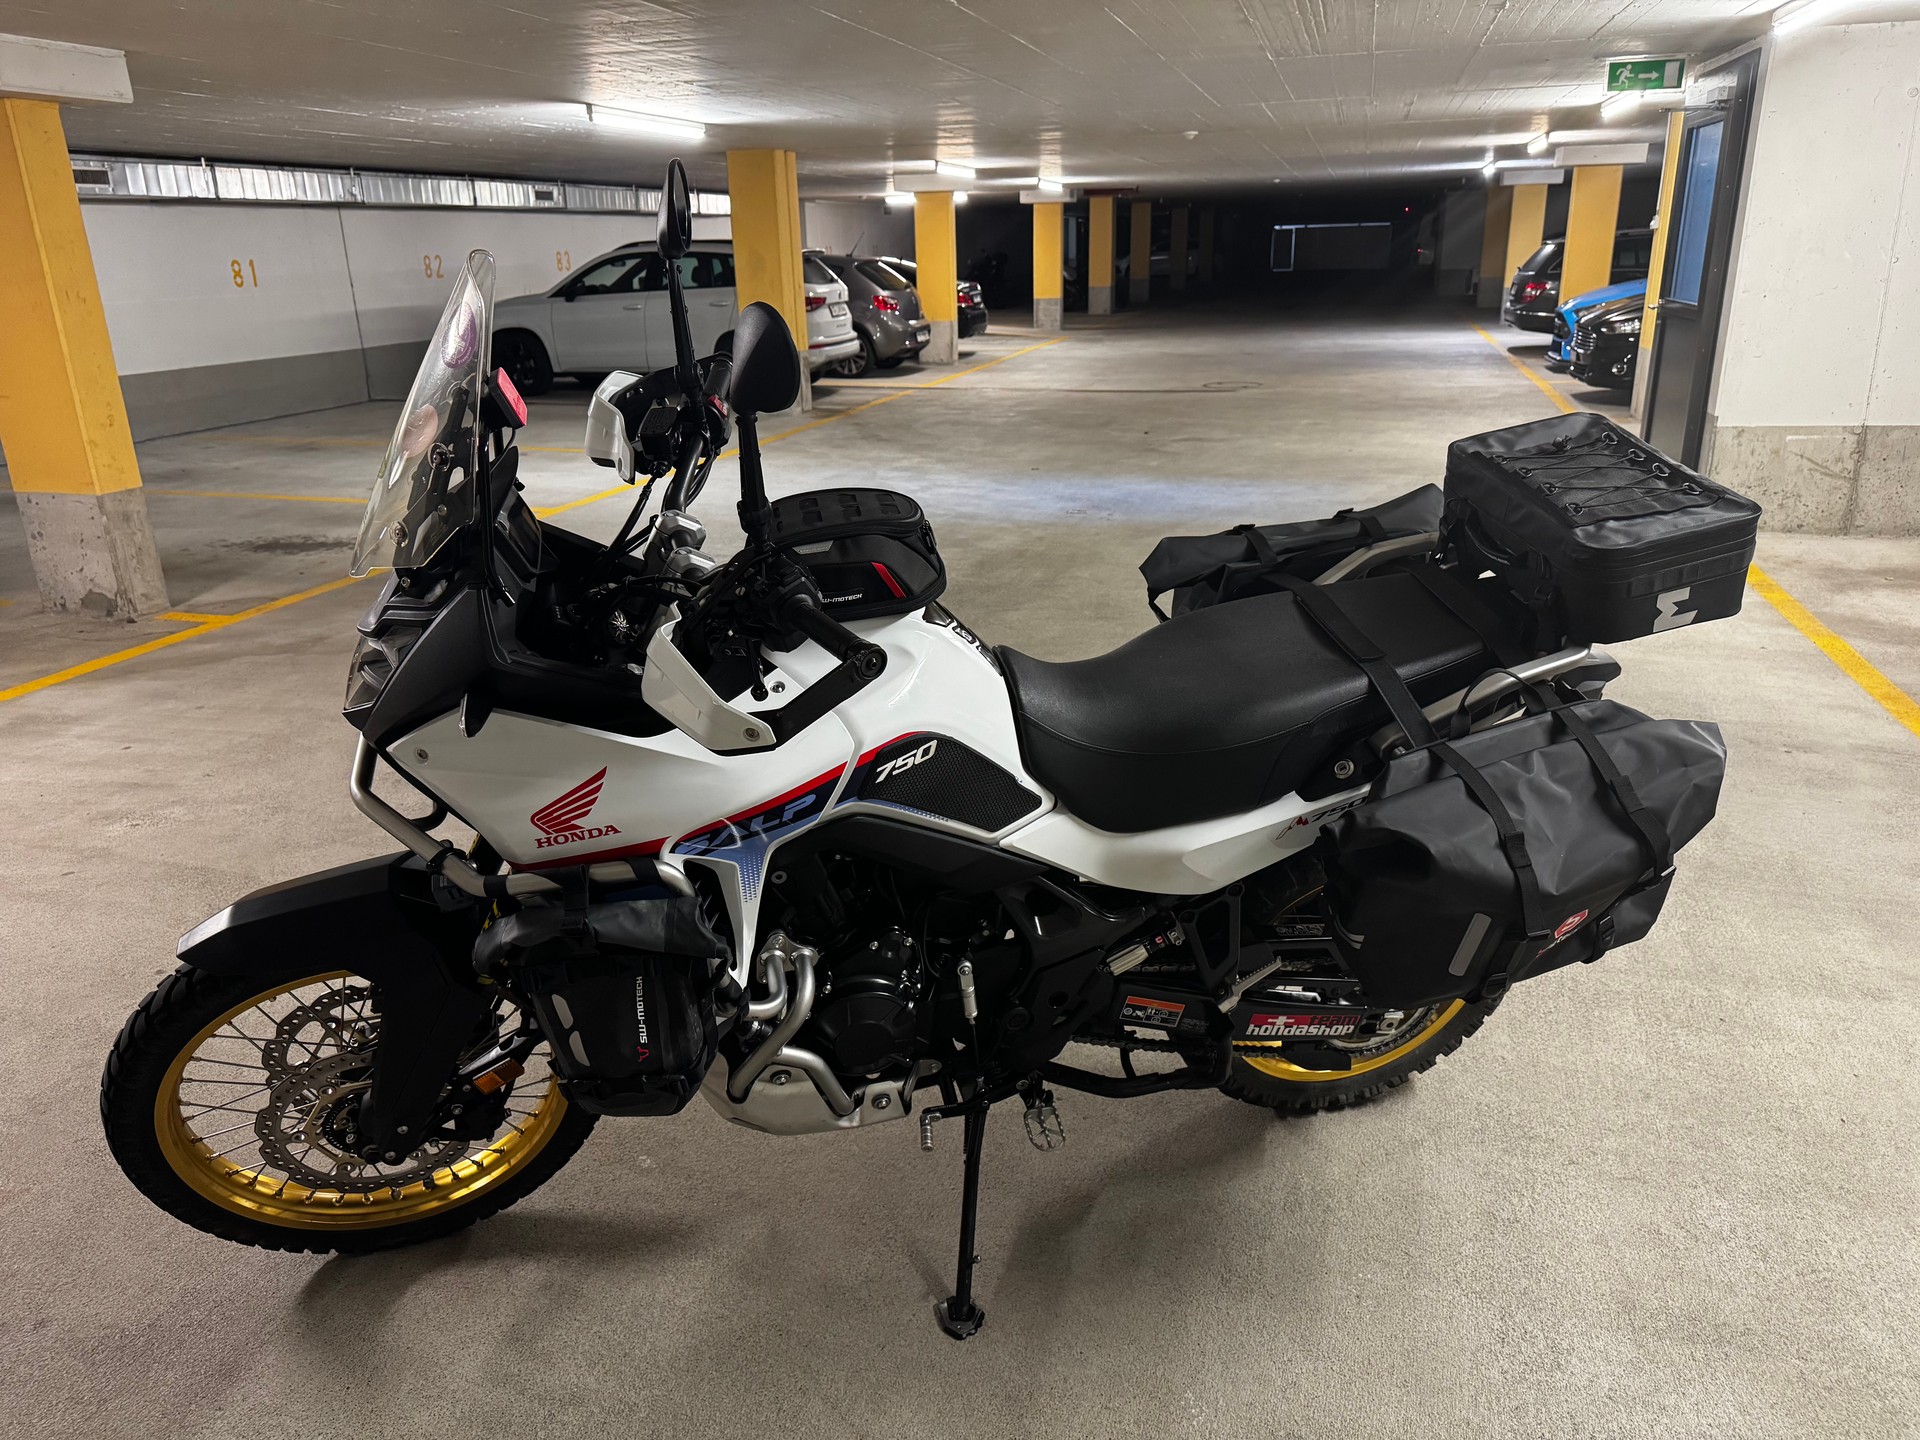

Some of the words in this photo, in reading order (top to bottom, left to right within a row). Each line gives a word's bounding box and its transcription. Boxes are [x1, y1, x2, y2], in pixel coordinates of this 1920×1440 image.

[230, 259, 257, 288] 81
[423, 255, 444, 279] 82
[556, 251, 571, 272] 83
[875, 740, 938, 783] 750
[534, 824, 622, 849] HONDA
[635, 976, 648, 1044] SW-MOTECH
